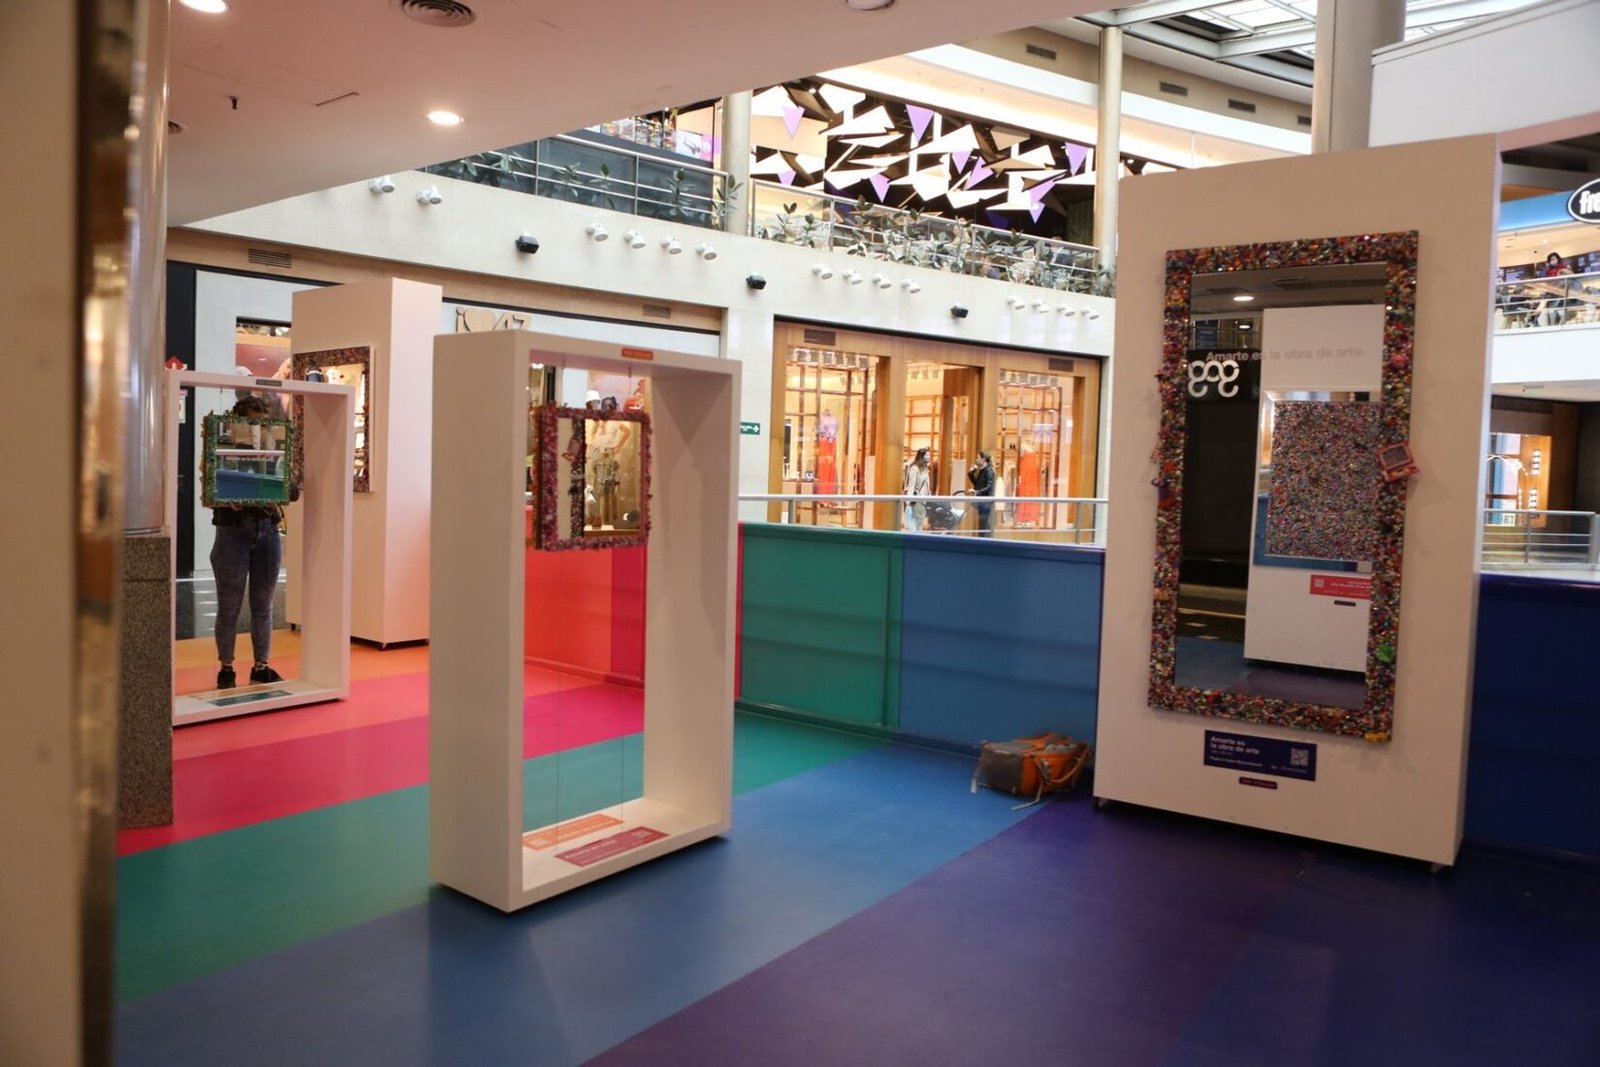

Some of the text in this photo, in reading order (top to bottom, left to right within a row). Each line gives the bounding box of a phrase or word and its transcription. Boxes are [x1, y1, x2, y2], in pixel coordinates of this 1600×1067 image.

[1205, 351, 1249, 361] Amarte
[1251, 352, 1266, 361] es
[1283, 348, 1313, 359] obra
[1316, 347, 1333, 358] de
